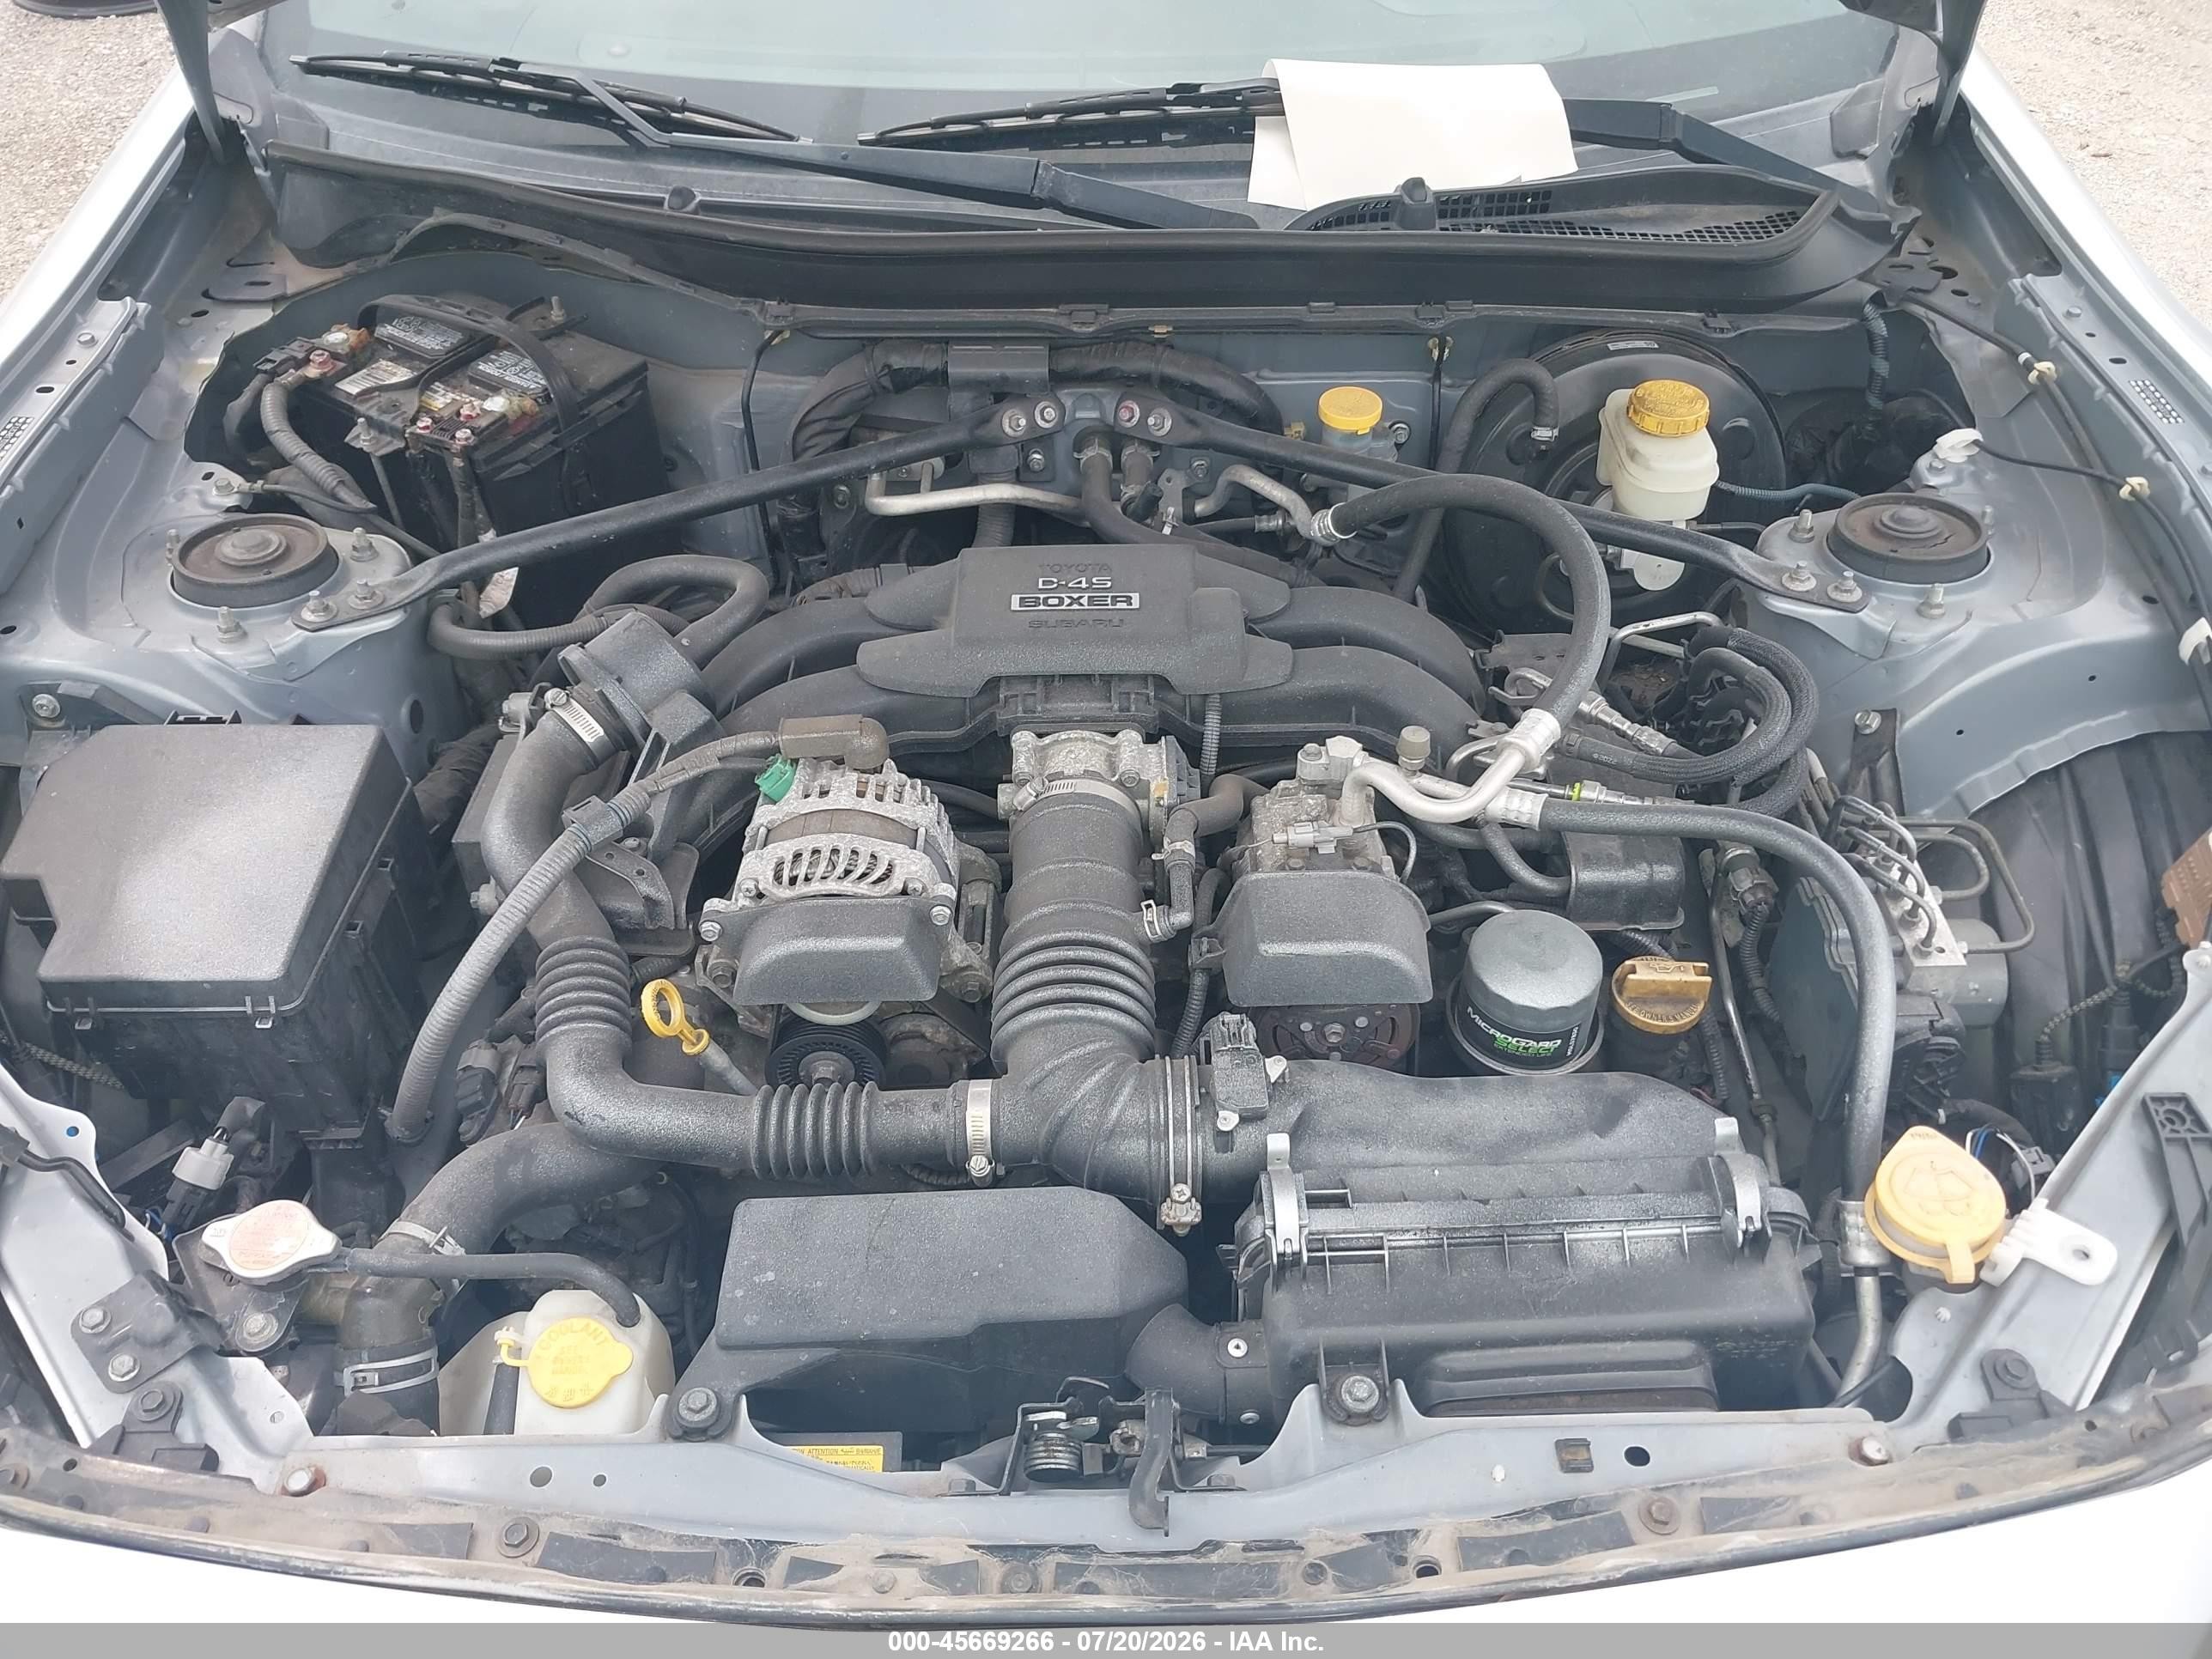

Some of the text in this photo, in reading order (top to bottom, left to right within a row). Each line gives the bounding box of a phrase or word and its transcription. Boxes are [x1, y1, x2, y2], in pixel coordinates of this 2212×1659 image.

[1038, 562, 1113, 574] TOYOTA
[1037, 576, 1113, 590] D-4S
[1018, 594, 1133, 608] BOXER
[1028, 618, 1125, 629] SUBARU
[1625, 1001, 1640, 1014] SEE
[1674, 1003, 1701, 1022] MANUAL
[1467, 1006, 1562, 1048] MICROGARD
[1494, 1037, 1559, 1054] SELECT
[538, 1320, 611, 1351] COOLANT
